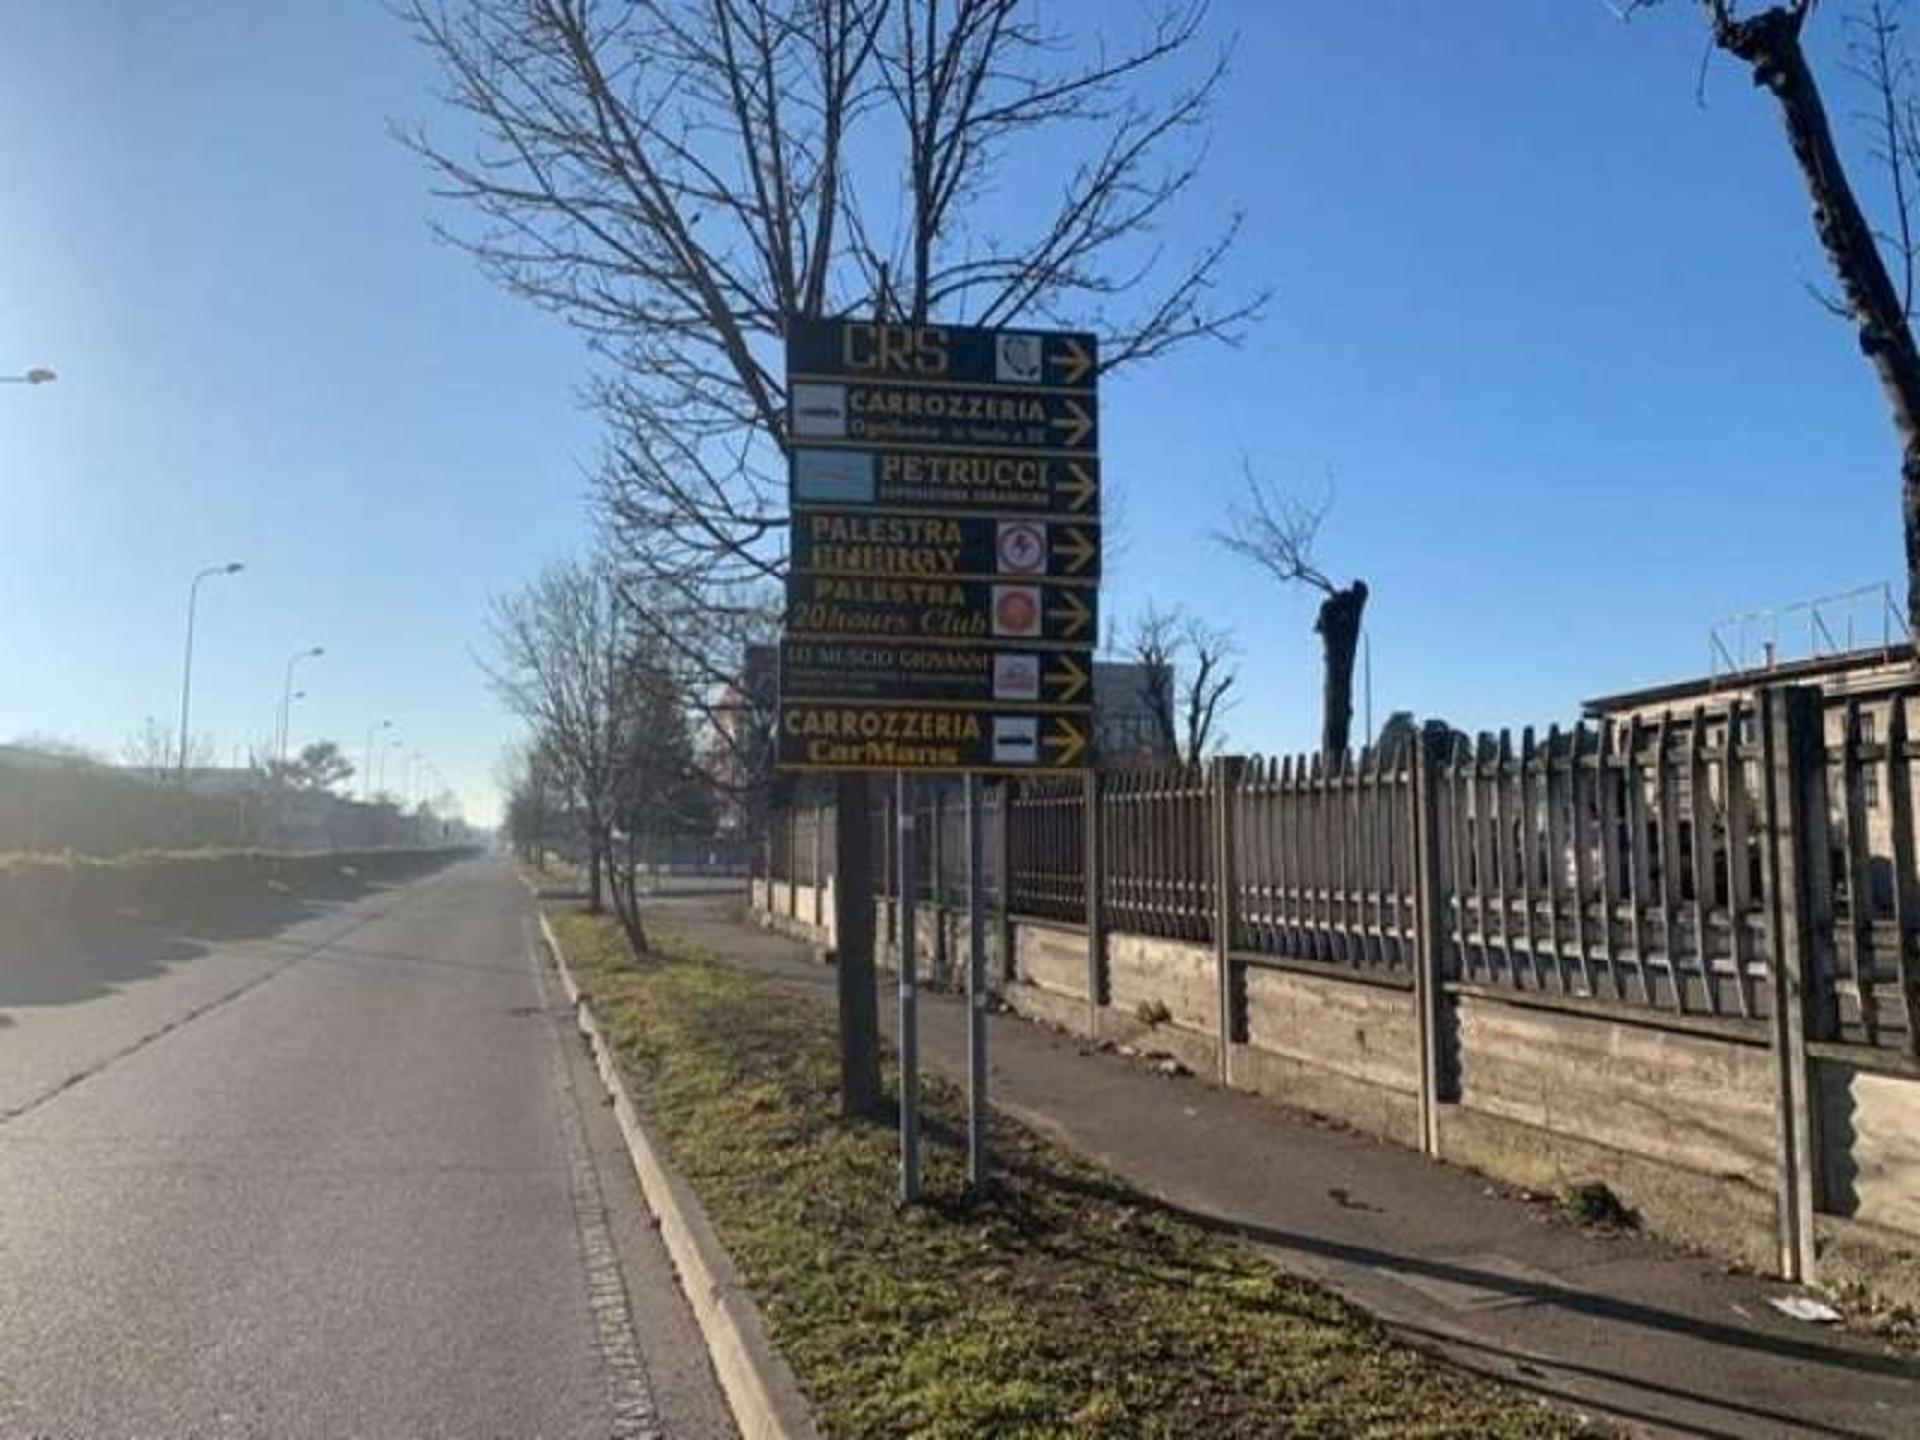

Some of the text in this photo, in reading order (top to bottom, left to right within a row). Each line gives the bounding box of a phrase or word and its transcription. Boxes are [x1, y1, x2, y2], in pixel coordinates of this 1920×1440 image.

[842, 325, 948, 374] CRS
[850, 390, 1046, 421] CARROZZERIA
[882, 455, 1049, 488] PETRUCCI
[811, 515, 962, 544] PALESTRA
[812, 544, 961, 574] ENERGY
[814, 579, 966, 605] PALESTRA
[784, 709, 982, 739] CARROZZERIA
